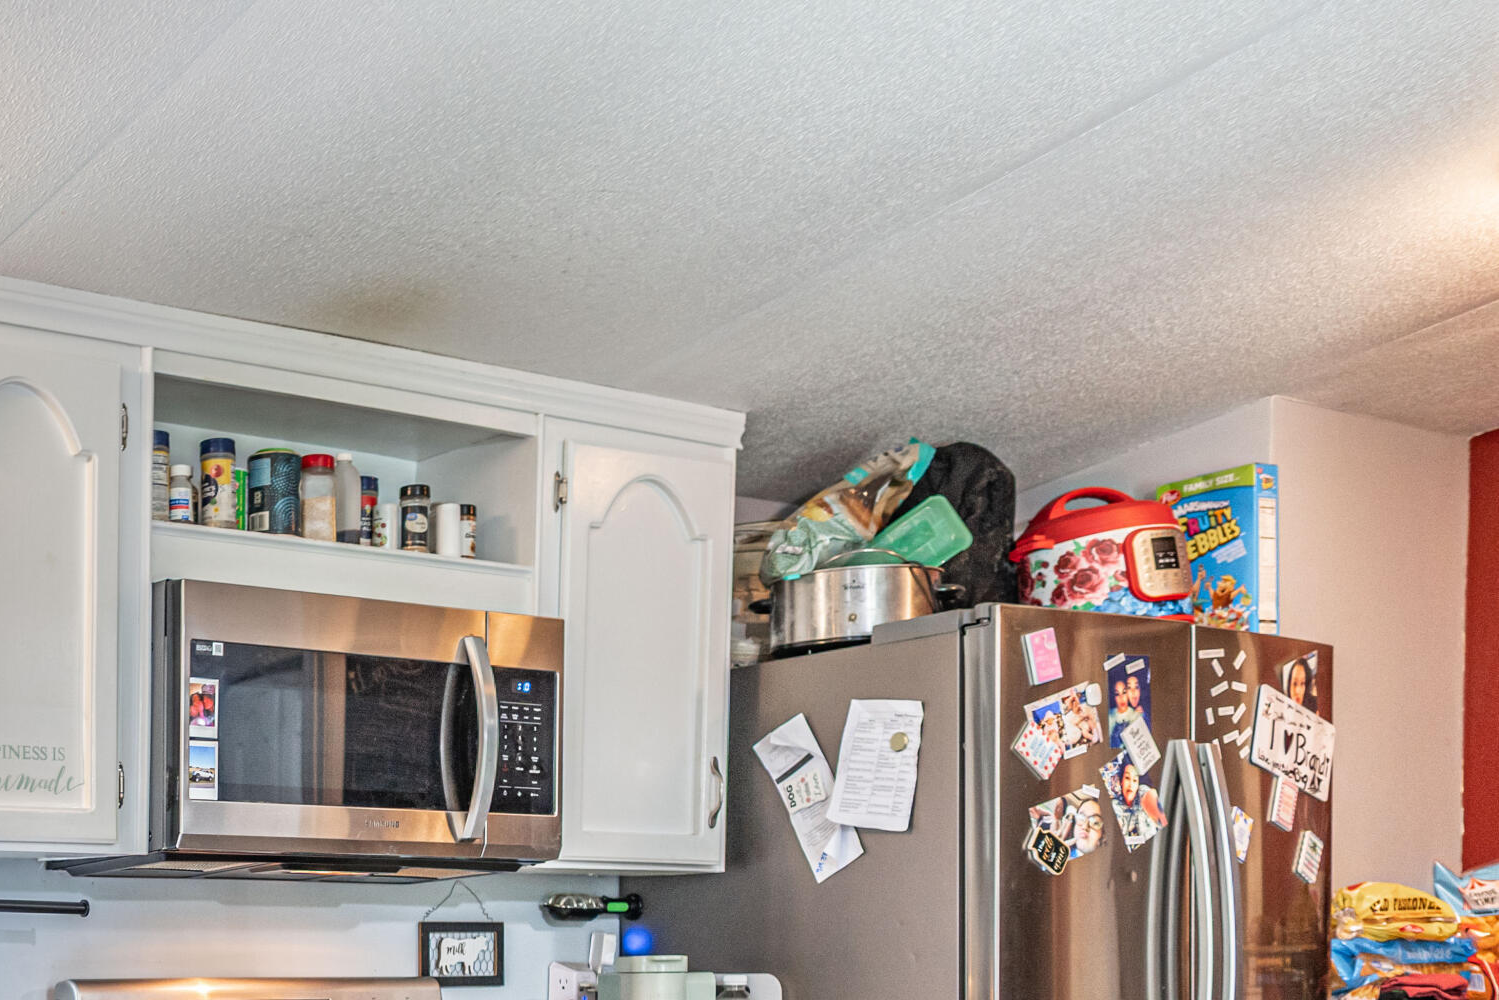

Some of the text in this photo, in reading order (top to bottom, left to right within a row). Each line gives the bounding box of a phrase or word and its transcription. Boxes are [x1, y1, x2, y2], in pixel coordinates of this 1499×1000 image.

[1183, 473, 1235, 493] FAMILY SIZE
[1186, 518, 1241, 561] EBBLES
[52, 747, 66, 761] IS
[786, 784, 797, 808] DOG
